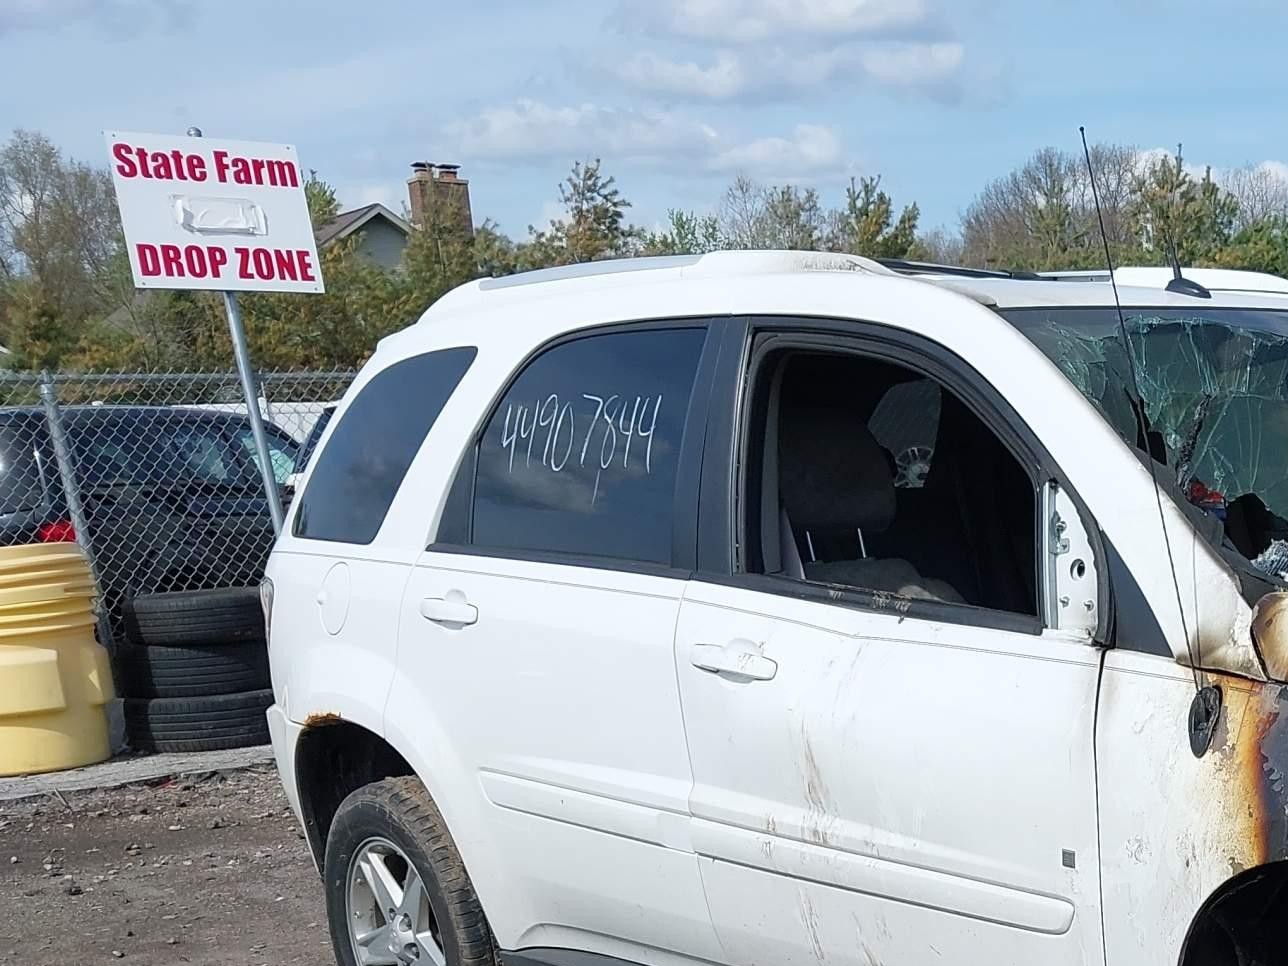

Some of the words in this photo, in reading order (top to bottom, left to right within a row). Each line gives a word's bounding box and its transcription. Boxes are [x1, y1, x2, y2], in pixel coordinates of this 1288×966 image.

[113, 143, 208, 182] State
[213, 150, 299, 188] Farm
[136, 243, 228, 279] DROP
[234, 247, 316, 282] ZONE
[502, 394, 662, 474] 44907844
